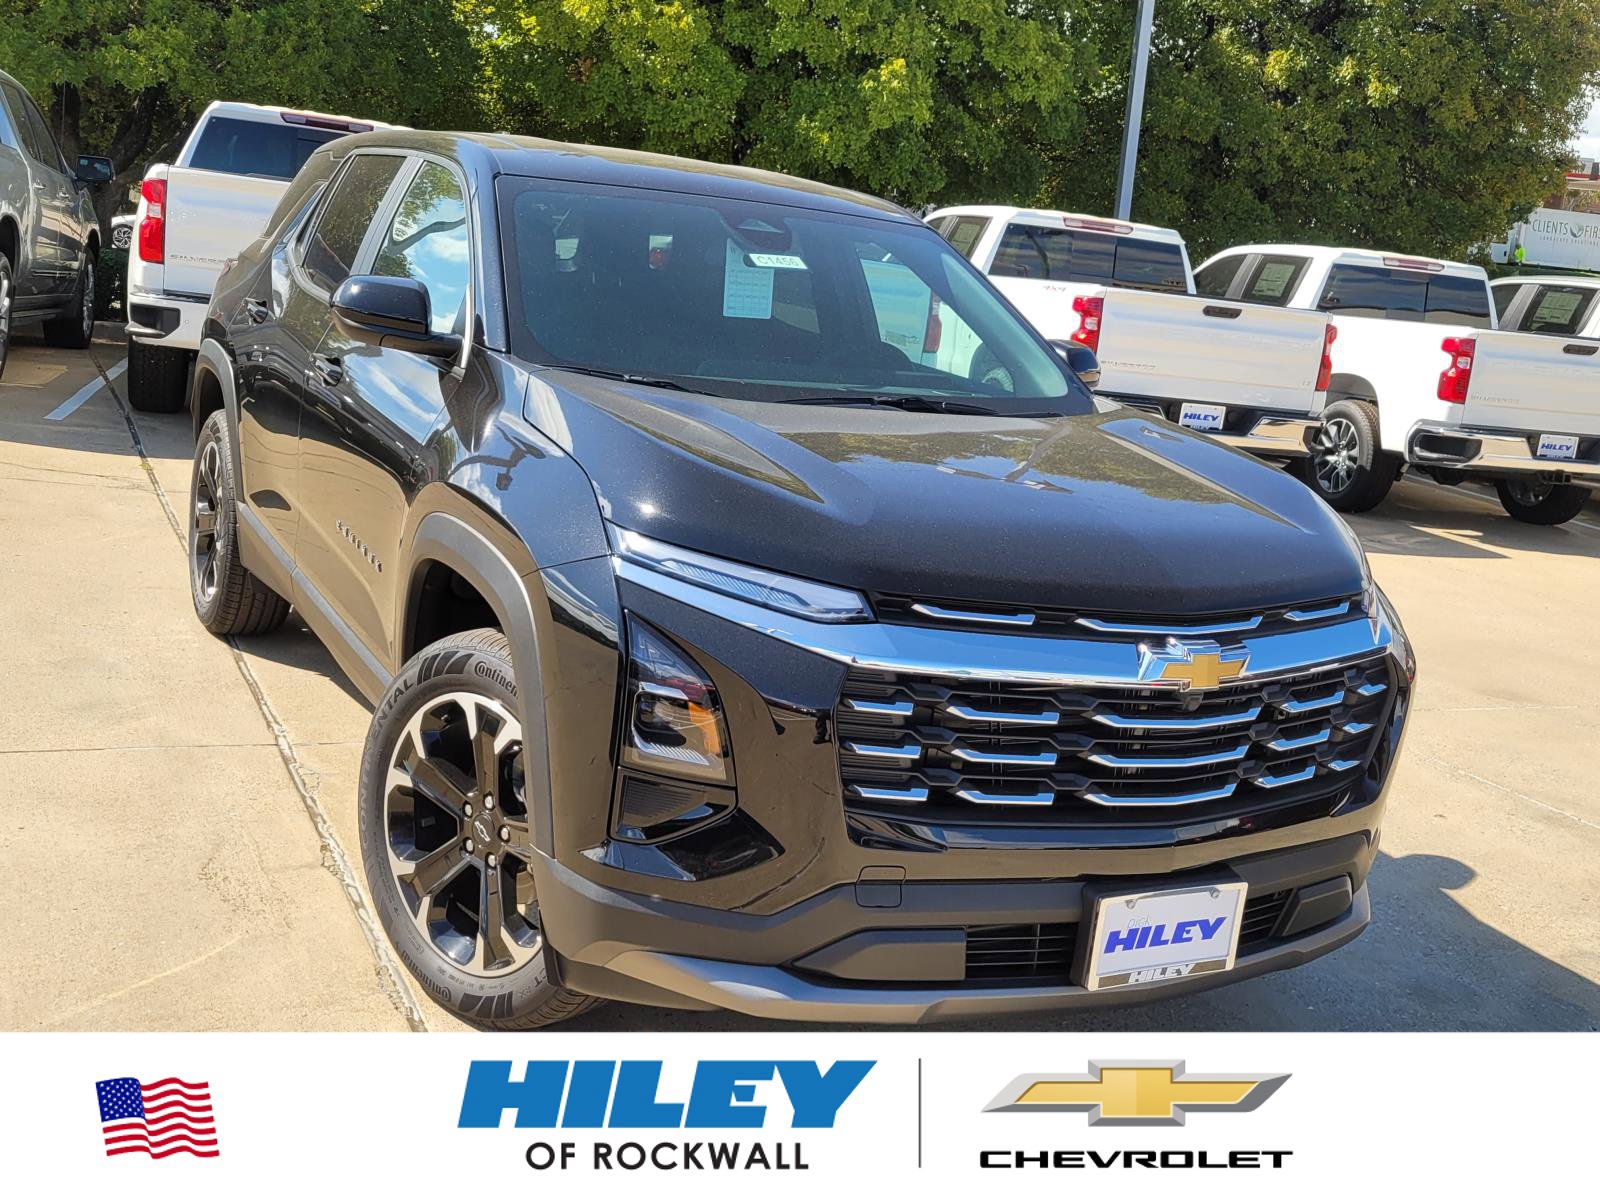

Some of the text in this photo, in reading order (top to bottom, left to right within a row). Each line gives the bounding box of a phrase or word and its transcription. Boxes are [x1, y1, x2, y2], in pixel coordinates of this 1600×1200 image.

[1532, 219, 1569, 235] CLIENTS
[756, 255, 800, 267] C1456
[1183, 412, 1220, 422] HILEY
[1541, 442, 1573, 452] HILEY
[1104, 916, 1228, 954] HILEY
[1128, 963, 1196, 984] HILEY
